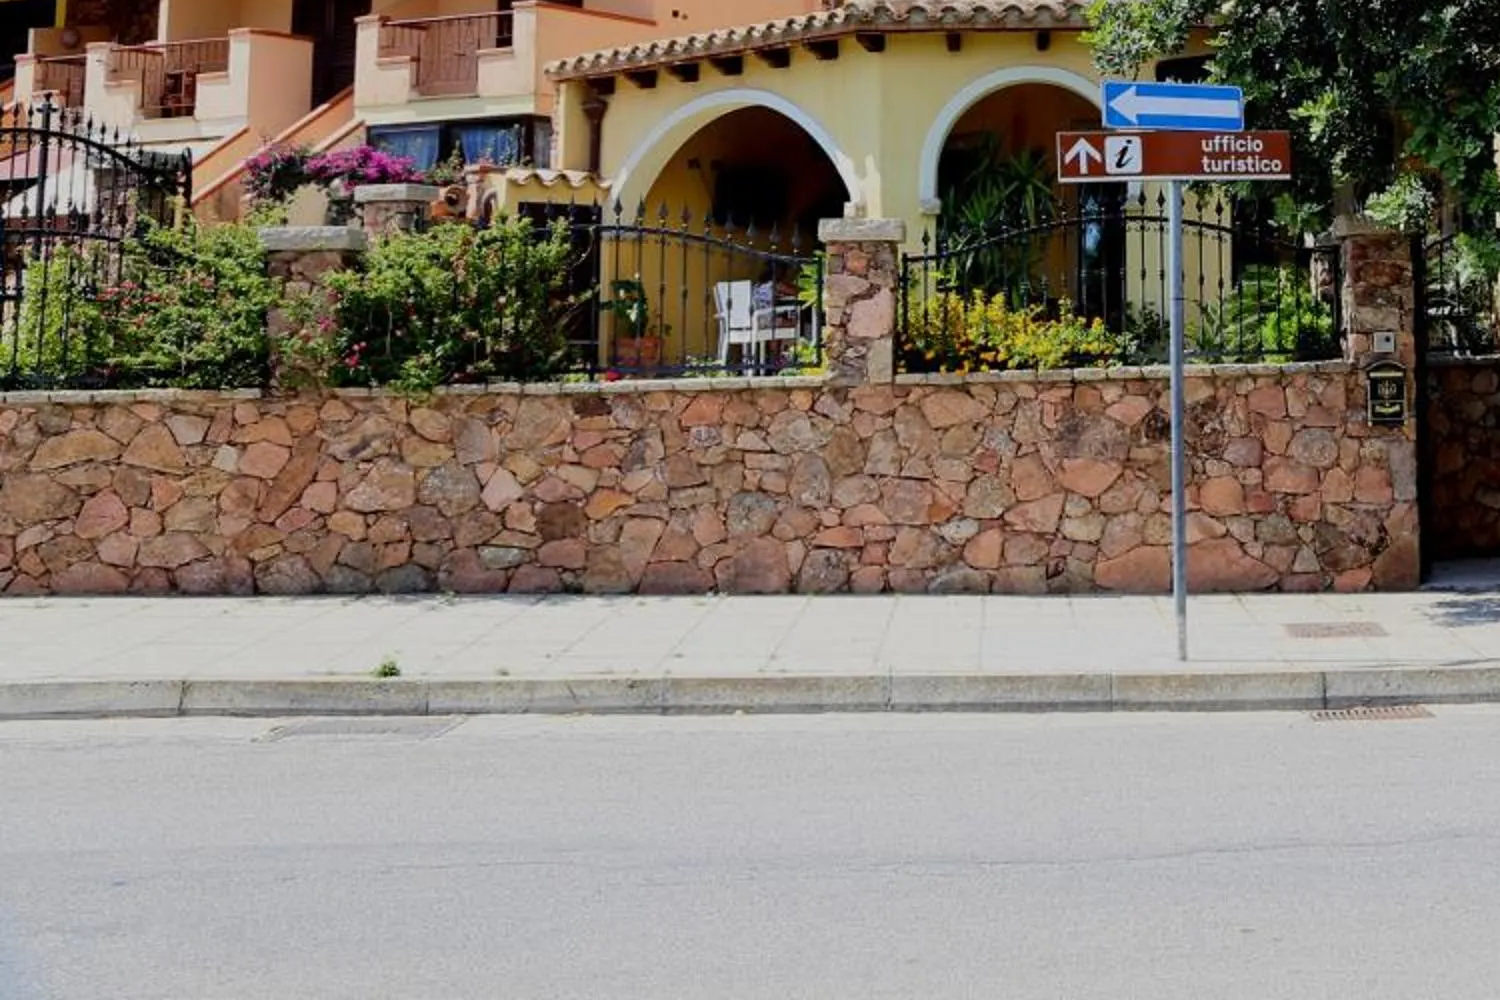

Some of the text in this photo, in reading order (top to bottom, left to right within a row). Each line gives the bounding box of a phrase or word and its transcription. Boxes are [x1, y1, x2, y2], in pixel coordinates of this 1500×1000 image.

[1201, 135, 1263, 153] ufficio
[1115, 139, 1133, 170] i
[1201, 154, 1282, 173] turistico
